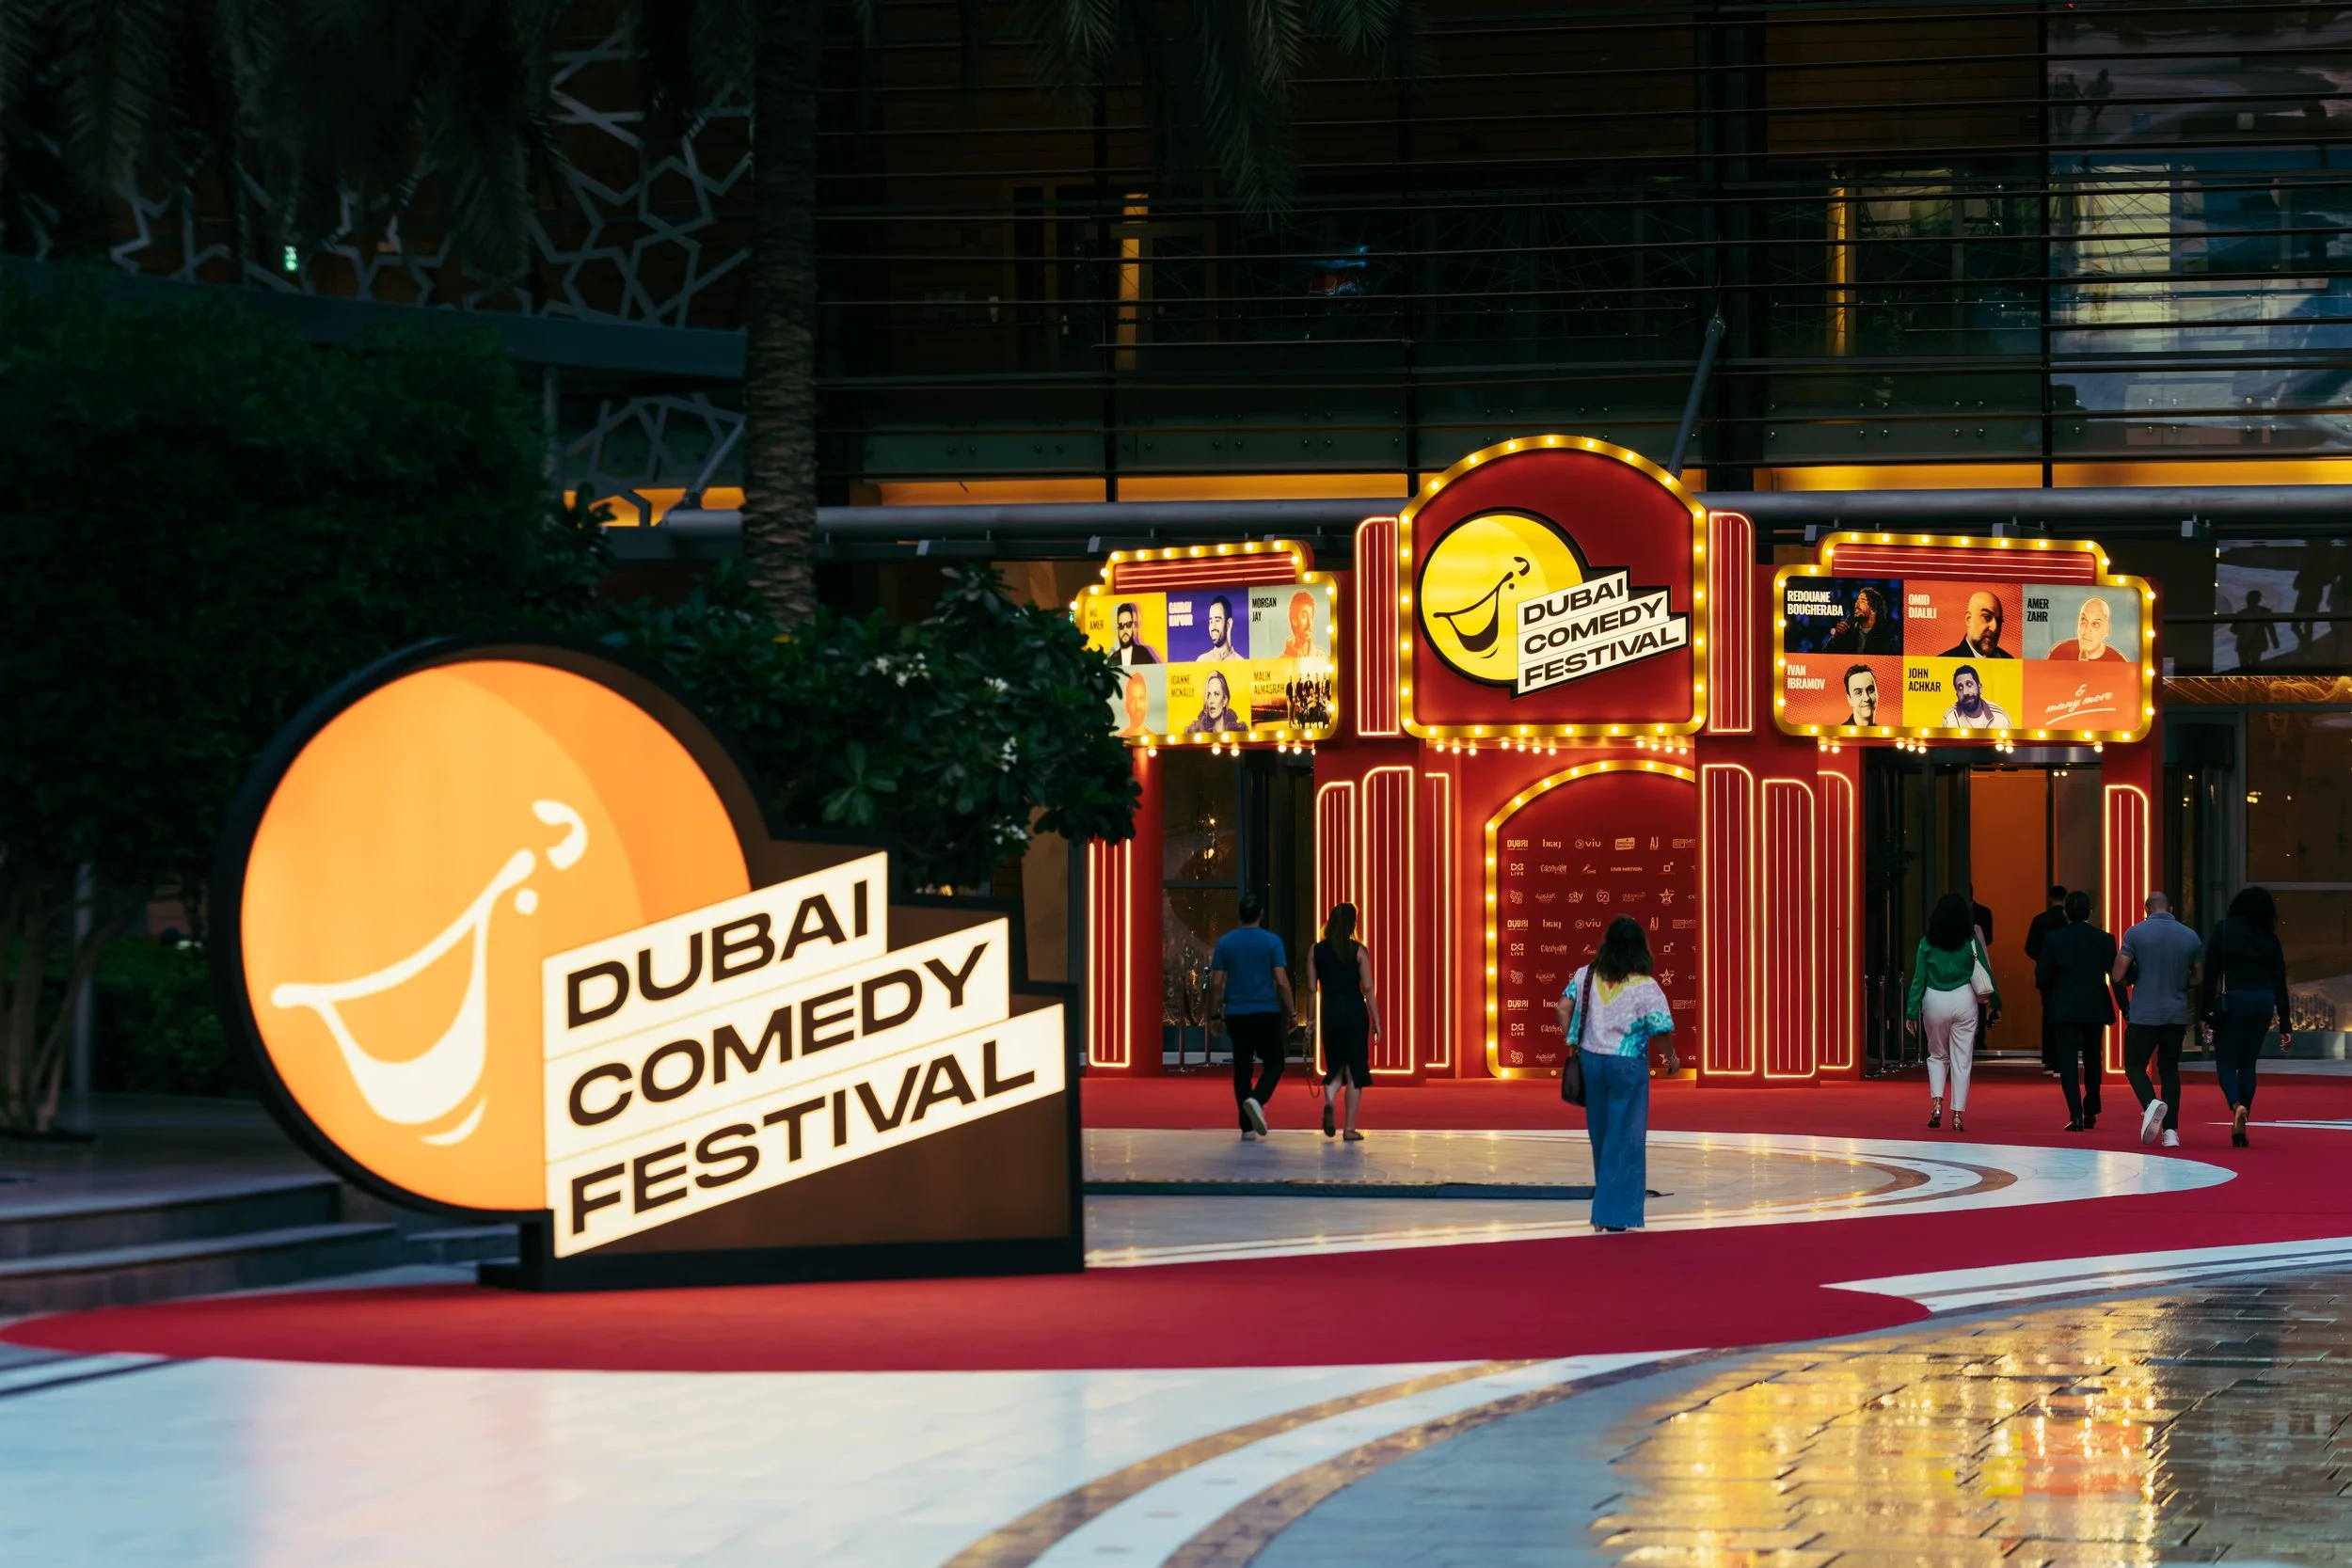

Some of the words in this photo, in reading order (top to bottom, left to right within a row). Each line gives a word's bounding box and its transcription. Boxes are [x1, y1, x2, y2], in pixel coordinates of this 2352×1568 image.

[1523, 578, 1623, 626] DUBAI
[1787, 590, 1831, 603] REDOUANE
[1908, 594, 1930, 606] OMID
[1251, 597, 1277, 609] MORGAN
[2026, 597, 2049, 610] AMER
[1787, 603, 1844, 616] BOUGHERABA
[1908, 607, 1937, 619] DJALILI
[1251, 611, 1262, 622] JAY
[2026, 611, 2048, 623] ZAHR
[1089, 620, 1104, 630] AMER
[1524, 596, 1663, 655] COMEDY
[1524, 627, 1679, 687] FESTIVAL
[1253, 671, 1272, 681] MALIK
[1787, 664, 1806, 676] IVAN
[1908, 667, 1929, 679] JOHN
[1170, 674, 1191, 686] JOANNE
[1787, 678, 1826, 690] IBRAMOV
[1908, 681, 1941, 692] ACHKAR
[2044, 698, 2082, 713] many
[2081, 691, 2113, 705] more
[1507, 839, 1529, 847] DUBAI
[1584, 838, 1601, 847] viu
[1507, 919, 1529, 927] DUBAI
[1585, 918, 1601, 927] viu
[566, 879, 868, 1030] DUBAI
[1507, 999, 1529, 1007] DUBAI
[567, 942, 990, 1127] COMEDY
[571, 1039, 1036, 1236] FESTIVAL
